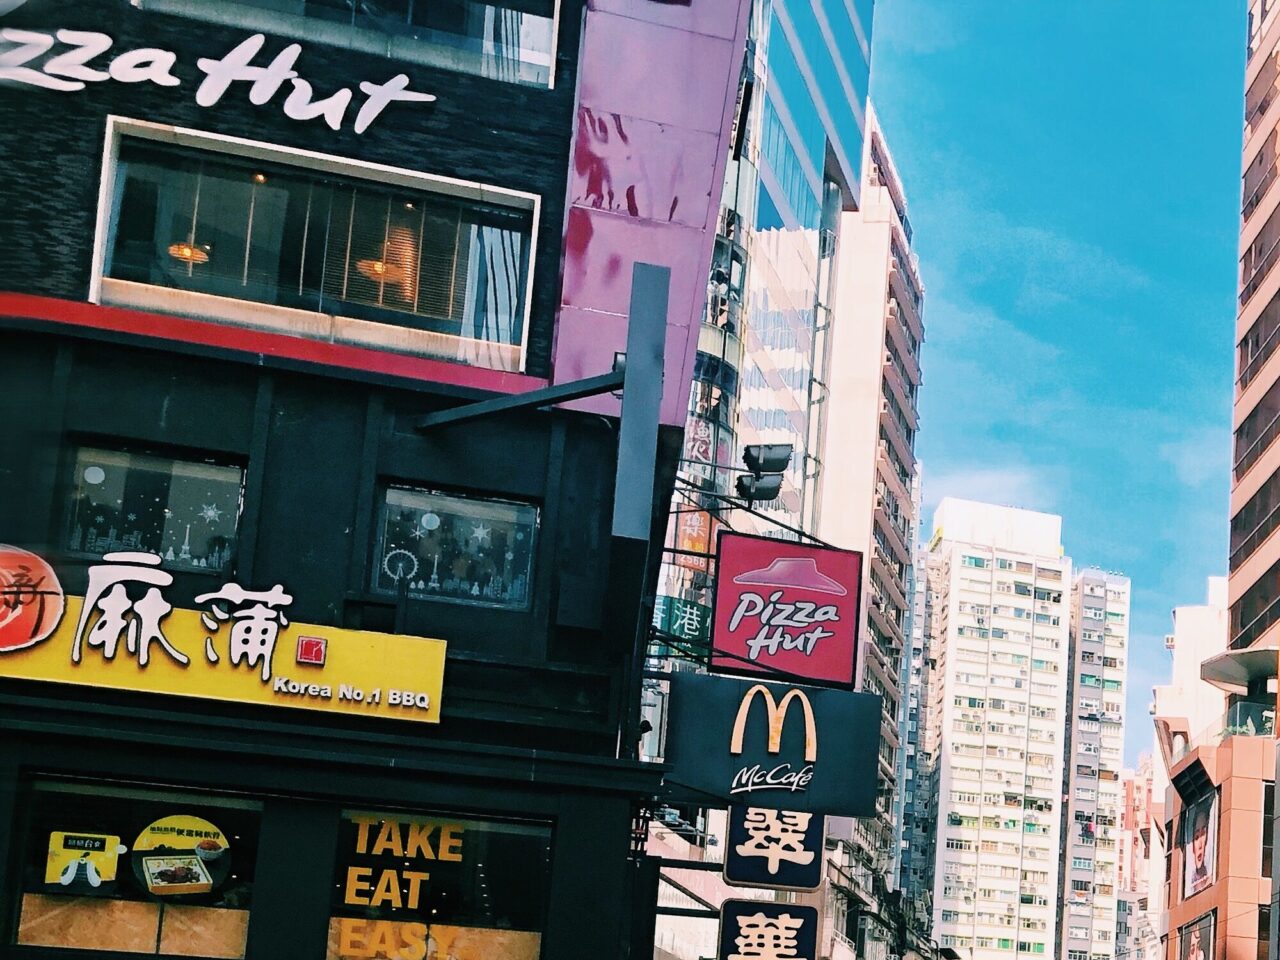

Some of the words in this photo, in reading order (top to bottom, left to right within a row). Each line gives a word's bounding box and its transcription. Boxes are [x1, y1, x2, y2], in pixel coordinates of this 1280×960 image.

[197, 33, 436, 133] Hut
[71, 551, 293, 681] 麻蒲
[729, 591, 840, 633] Pizza
[747, 626, 834, 661] Hut
[273, 676, 332, 698] Korea
[338, 685, 381, 705] No.1
[388, 688, 431, 711] BBQ
[730, 764, 814, 792] McCafé
[351, 816, 466, 863] TAKE
[345, 865, 430, 910] EAT
